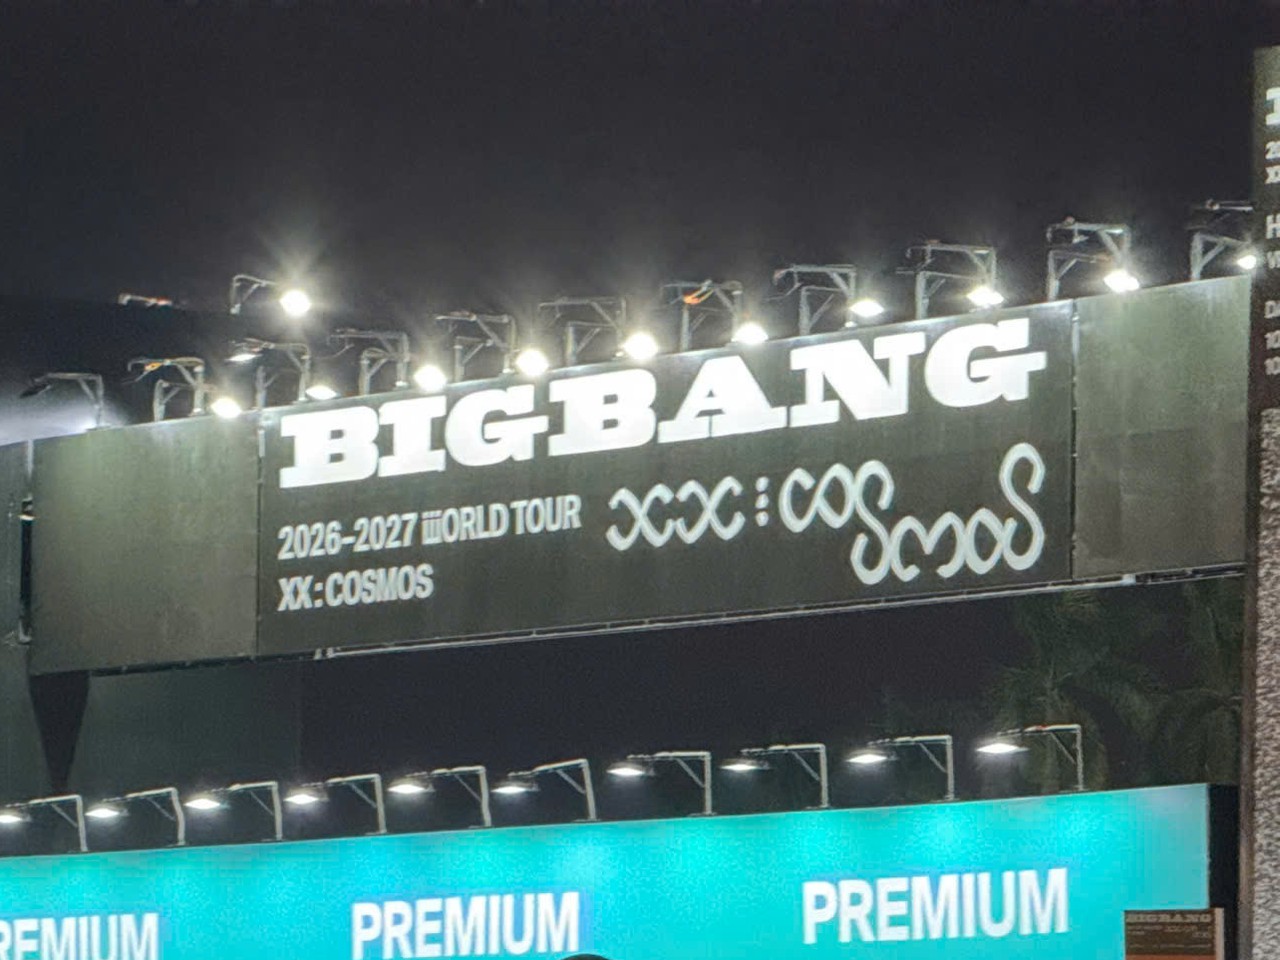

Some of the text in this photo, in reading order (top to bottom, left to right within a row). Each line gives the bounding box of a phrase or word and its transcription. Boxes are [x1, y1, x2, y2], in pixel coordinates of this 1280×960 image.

[278, 318, 1046, 489] BIGBANG
[277, 512, 418, 560] 2026-2027
[511, 494, 582, 535] TOUR
[801, 867, 1069, 945] PREMIUM
